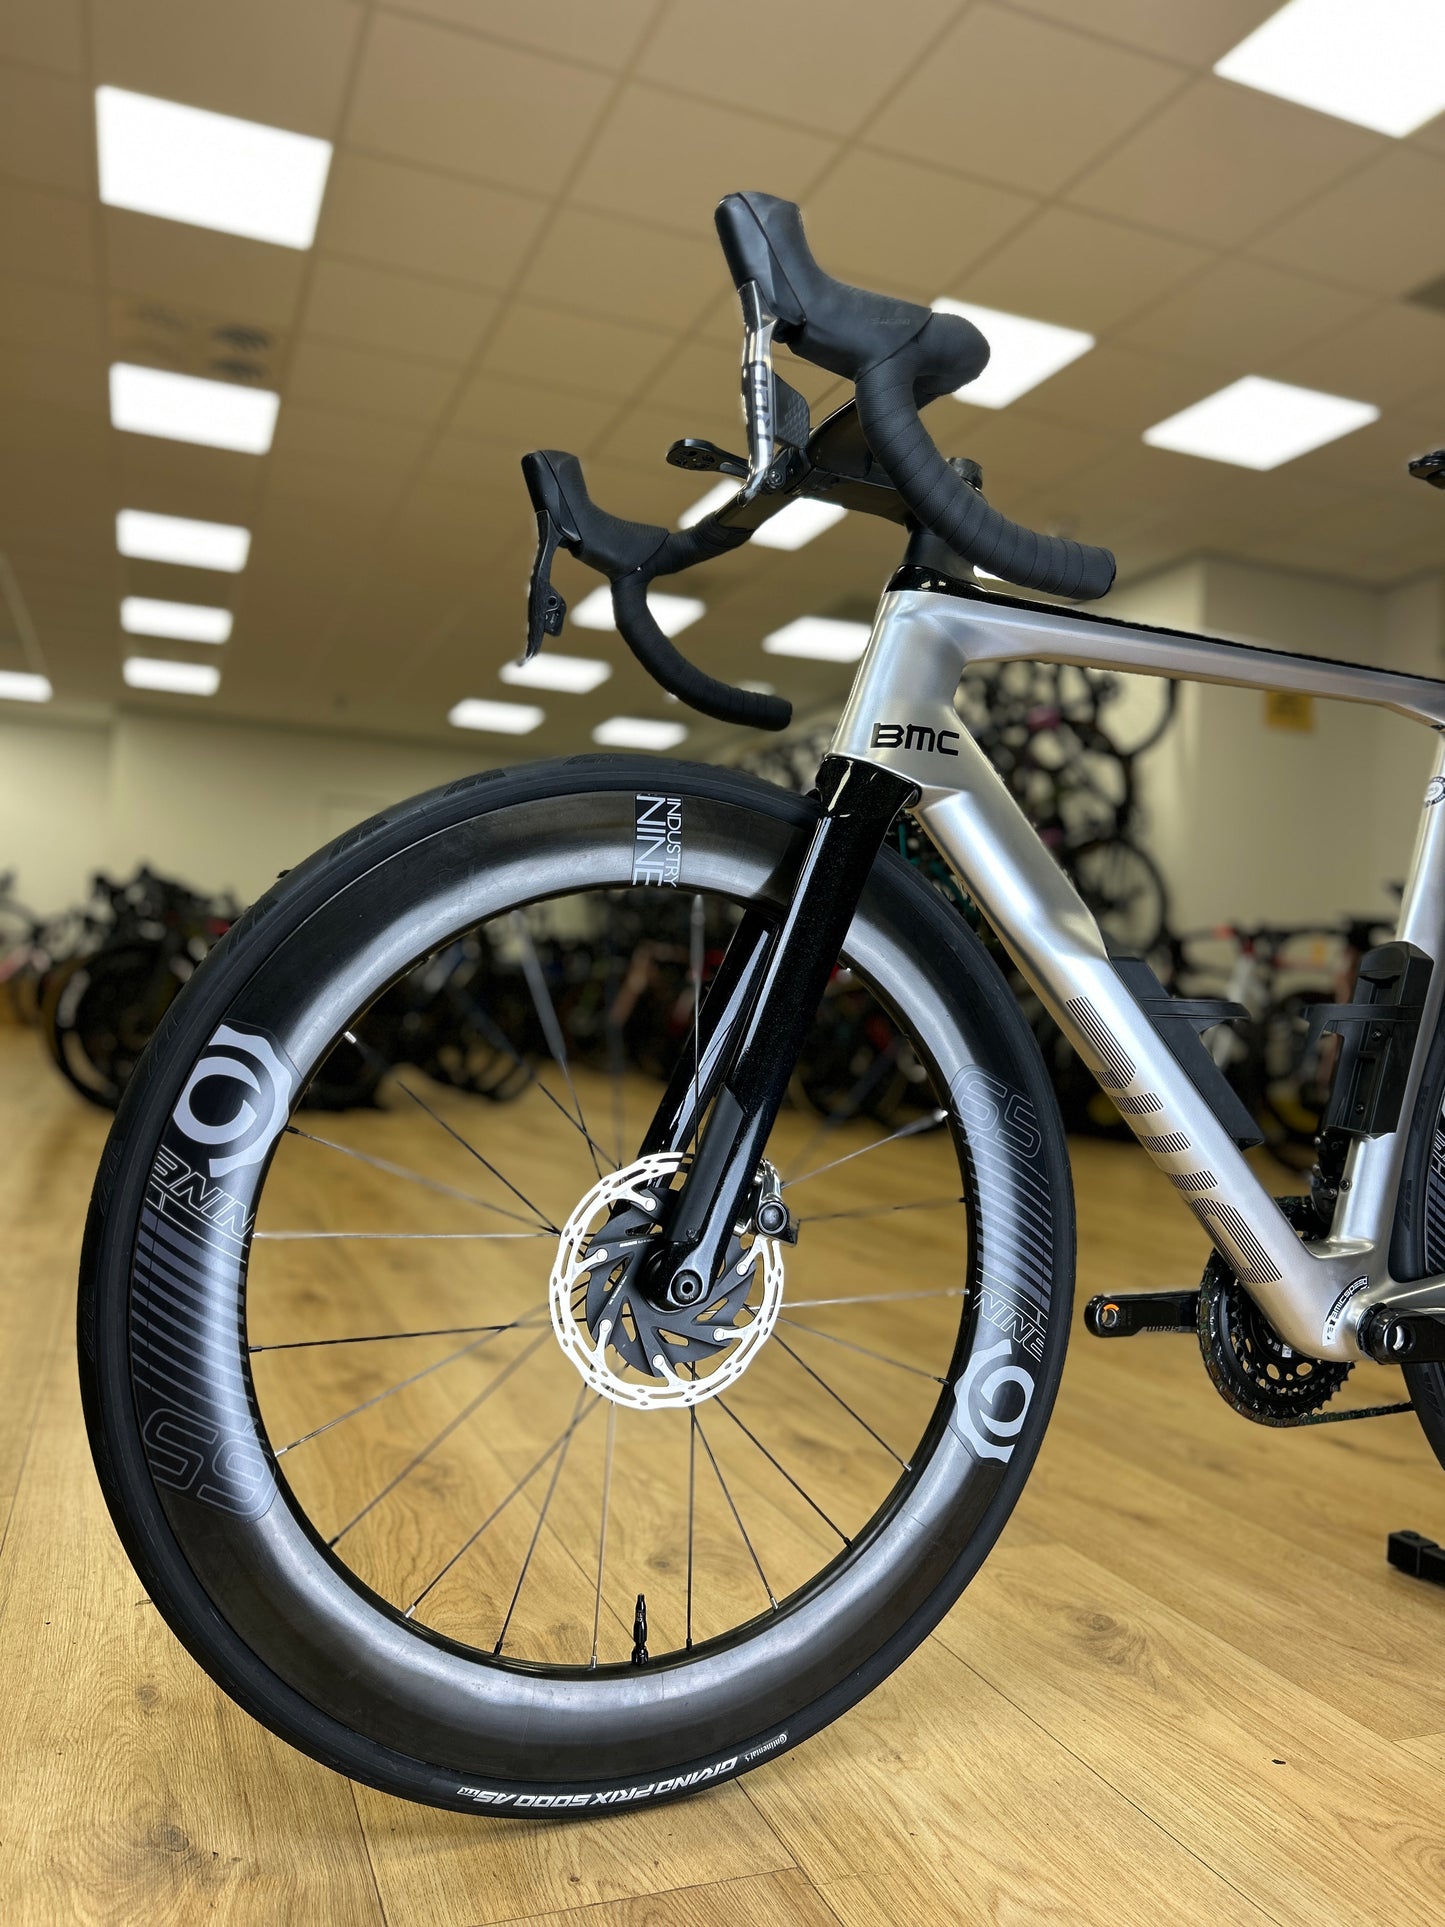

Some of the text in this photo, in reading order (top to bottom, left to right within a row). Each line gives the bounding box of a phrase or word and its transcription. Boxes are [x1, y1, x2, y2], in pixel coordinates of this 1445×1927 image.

[870, 722, 960, 756] BMC
[632, 795, 666, 886] NINE
[664, 798, 682, 888] INDUSTRY
[152, 1144, 255, 1239] NINE
[973, 1289, 1046, 1362] NINE
[750, 1732, 788, 1761] Continental
[654, 1756, 739, 1794] GRAND
[473, 1790, 517, 1804] AS
[513, 1794, 591, 1808] 5000
[590, 1784, 655, 1806] PRIX
